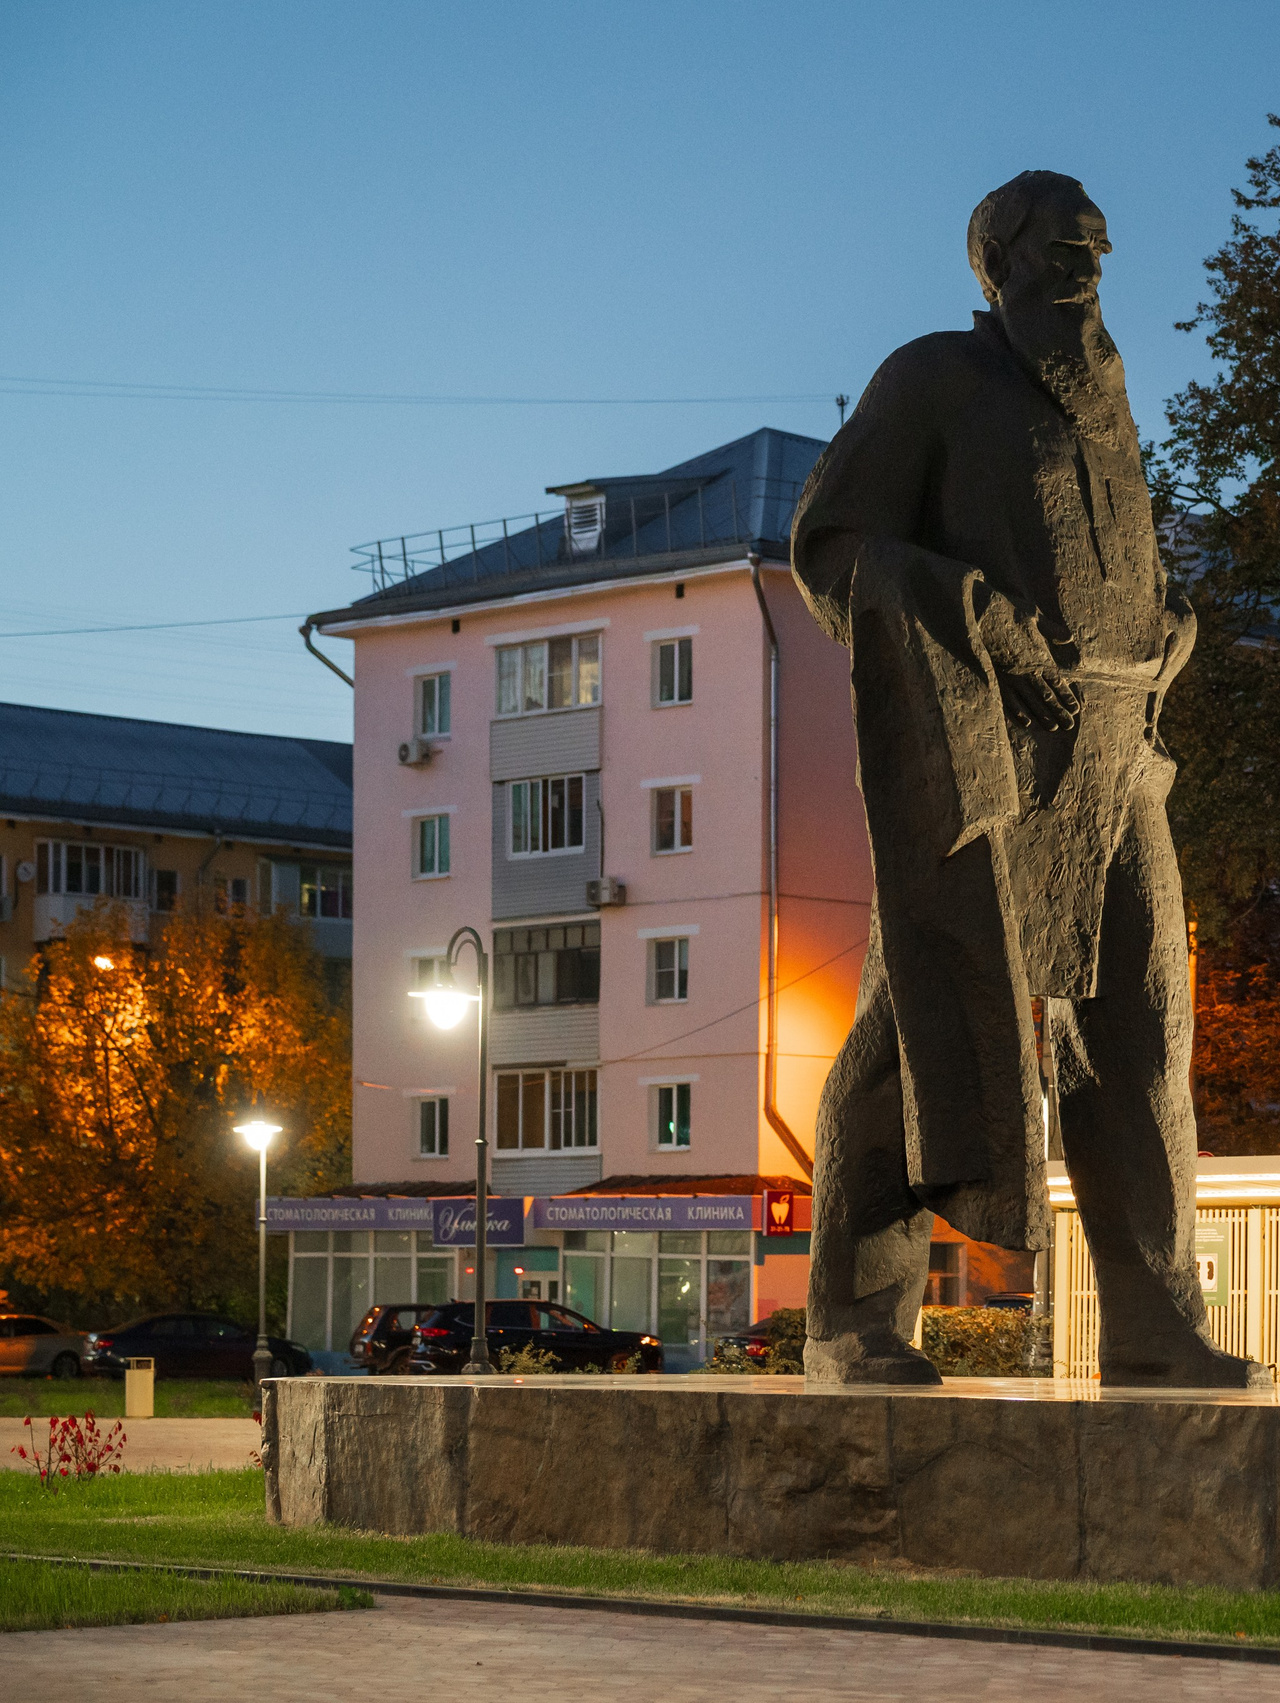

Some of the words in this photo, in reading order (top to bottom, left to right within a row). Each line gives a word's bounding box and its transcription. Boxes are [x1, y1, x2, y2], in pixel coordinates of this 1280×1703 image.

[266, 1207, 376, 1222] СТОМАТОЛОГИЧЕСКАЯ
[546, 1206, 673, 1221] СТОМАТОЛОГИЧЕСКАЯ
[687, 1206, 745, 1220] КЛИНИКА
